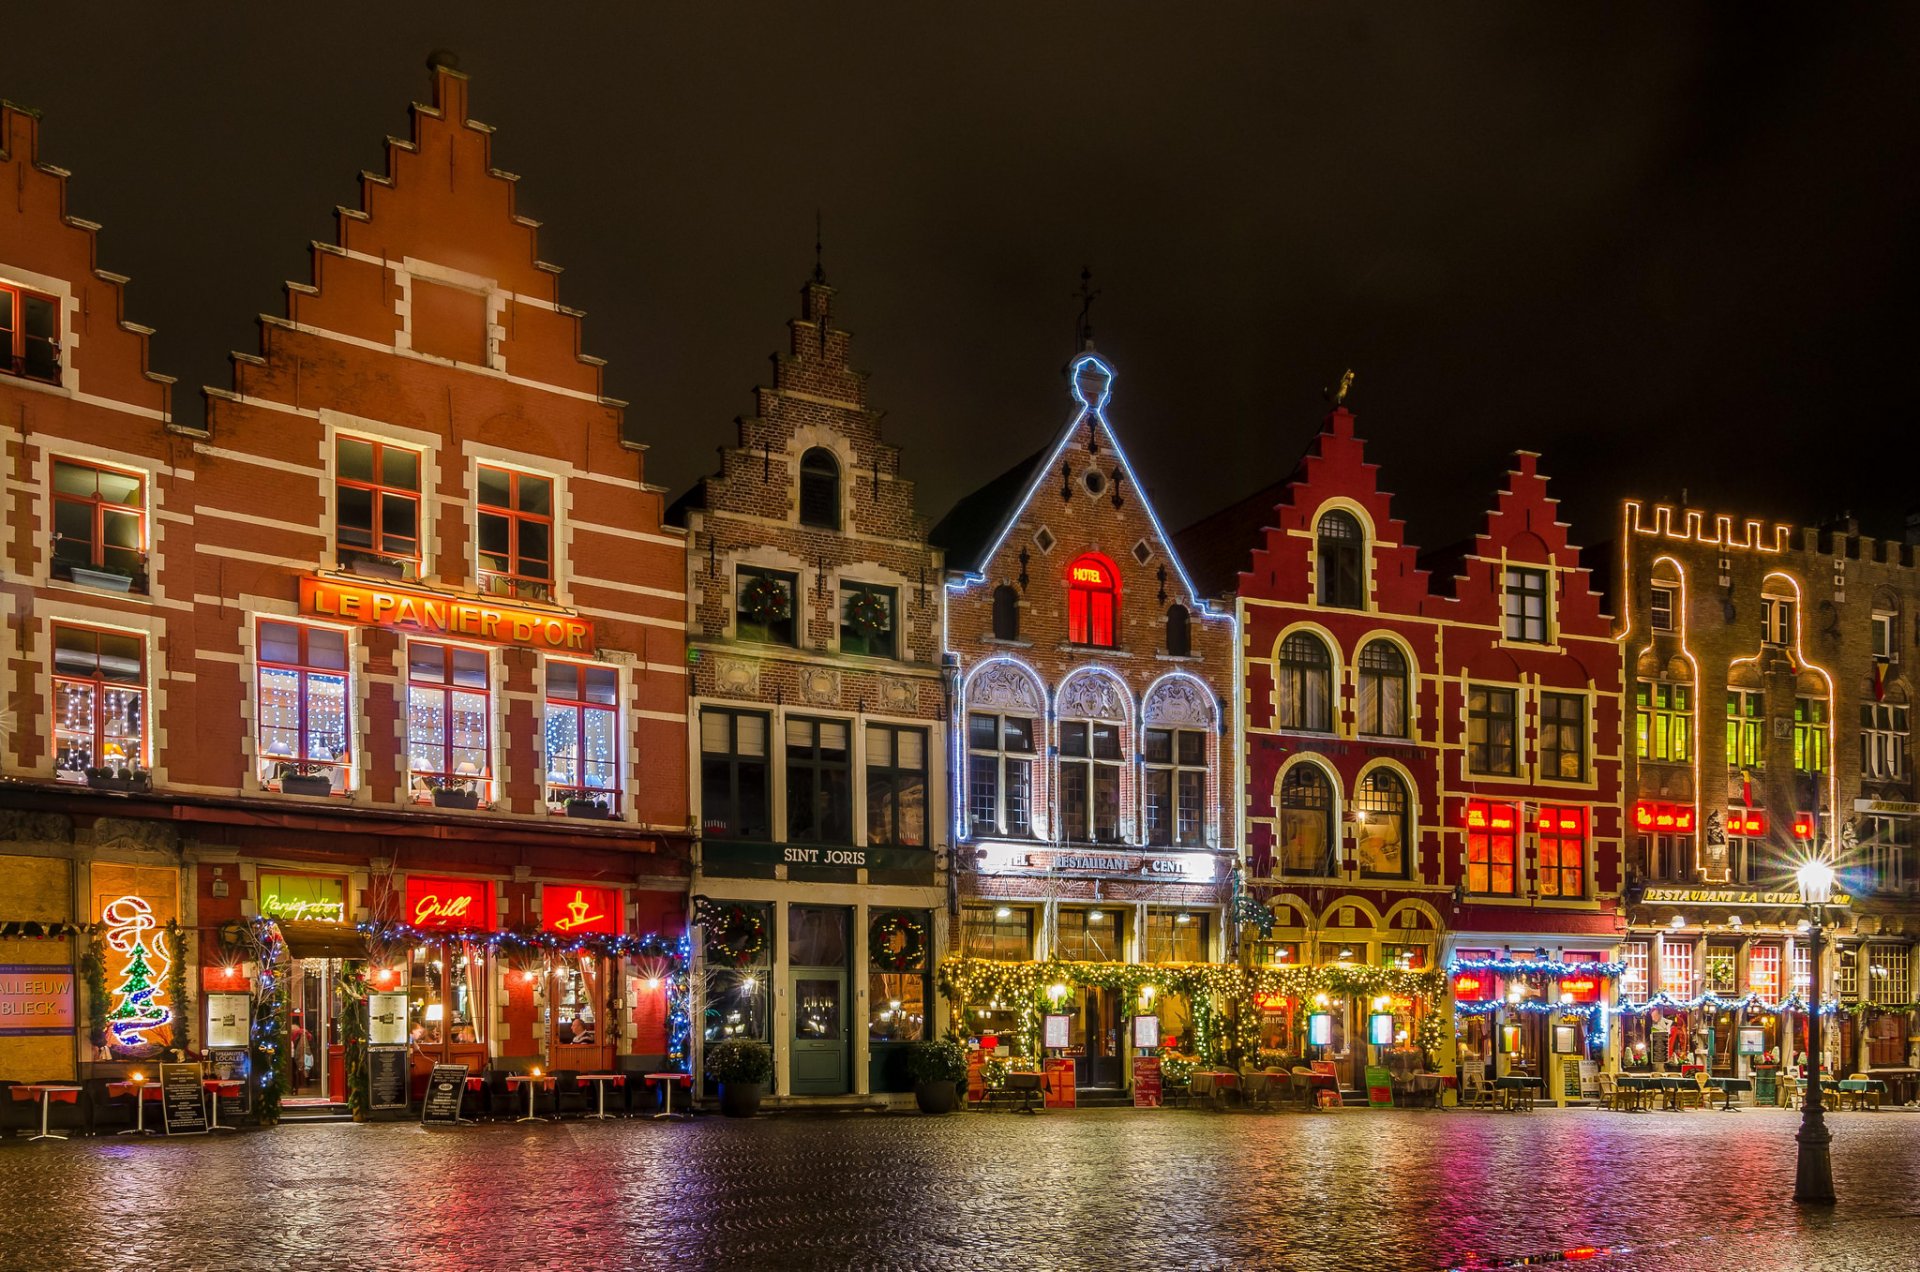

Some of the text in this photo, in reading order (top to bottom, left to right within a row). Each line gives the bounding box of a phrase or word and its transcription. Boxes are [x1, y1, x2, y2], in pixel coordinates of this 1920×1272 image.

[1073, 567, 1102, 583] HOTEL
[315, 590, 587, 649] LE PANIER D'OR
[784, 848, 866, 865] SINT JORIS
[1053, 856, 1130, 871] RESTAURANT
[1645, 889, 1736, 903] RESTAURANT
[1739, 891, 1758, 903] LA
[415, 895, 472, 925] Grill
[1, 1002, 56, 1016] BLIECK
